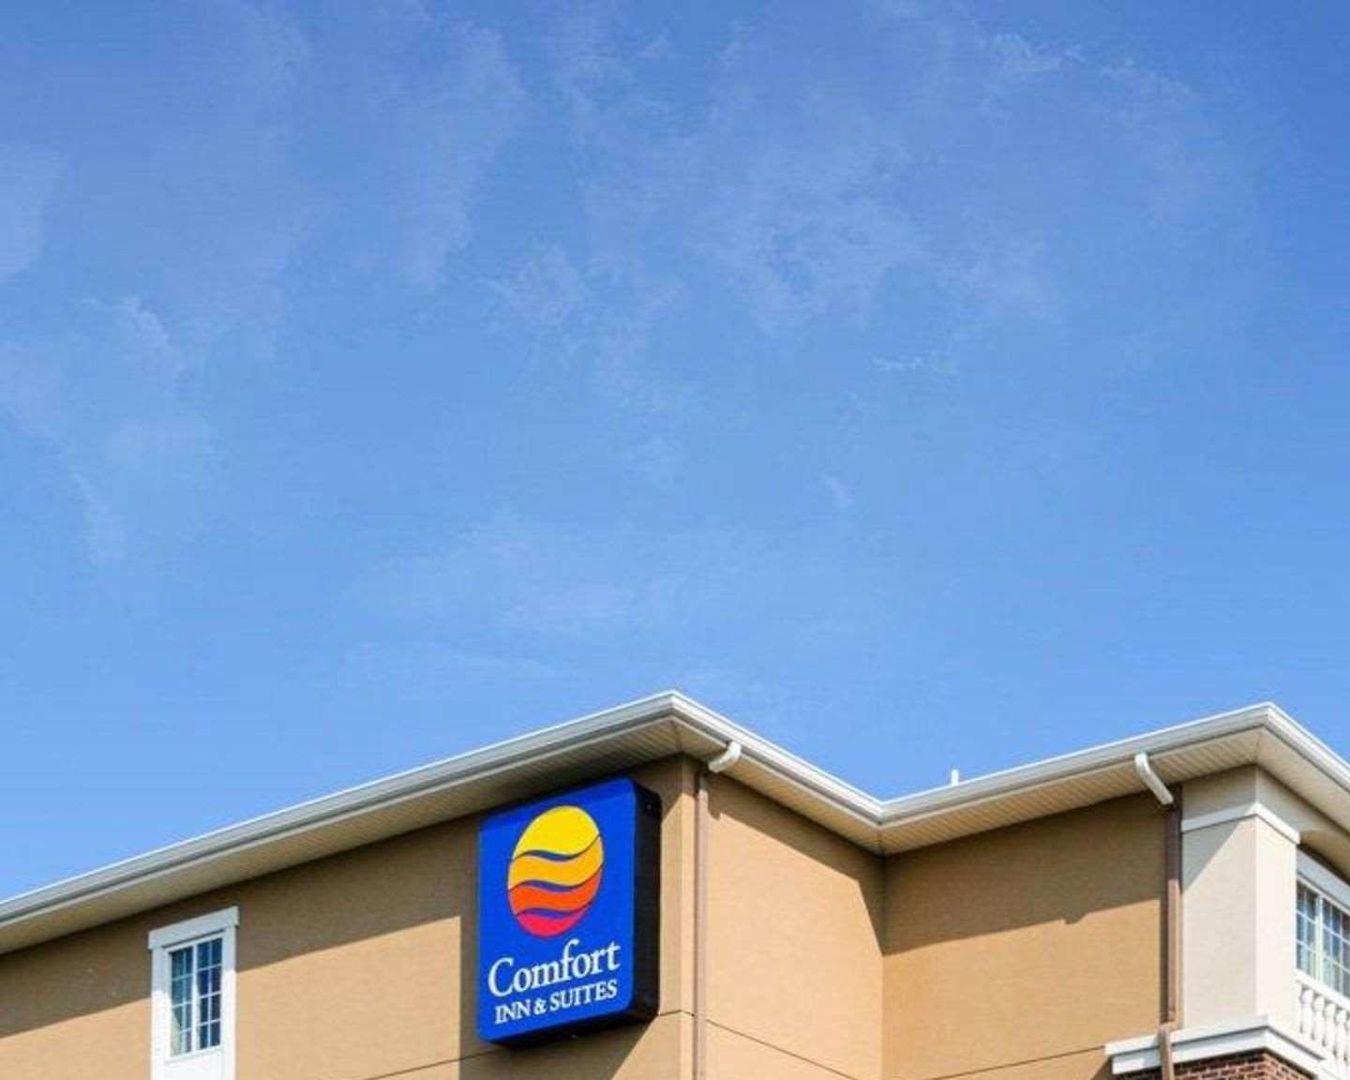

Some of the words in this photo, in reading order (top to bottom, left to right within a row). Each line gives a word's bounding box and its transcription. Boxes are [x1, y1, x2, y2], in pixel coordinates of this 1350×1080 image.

[488, 938, 620, 997] Comfort
[495, 999, 531, 1024] INN
[533, 997, 546, 1015] &
[549, 979, 617, 1011] SUITES
